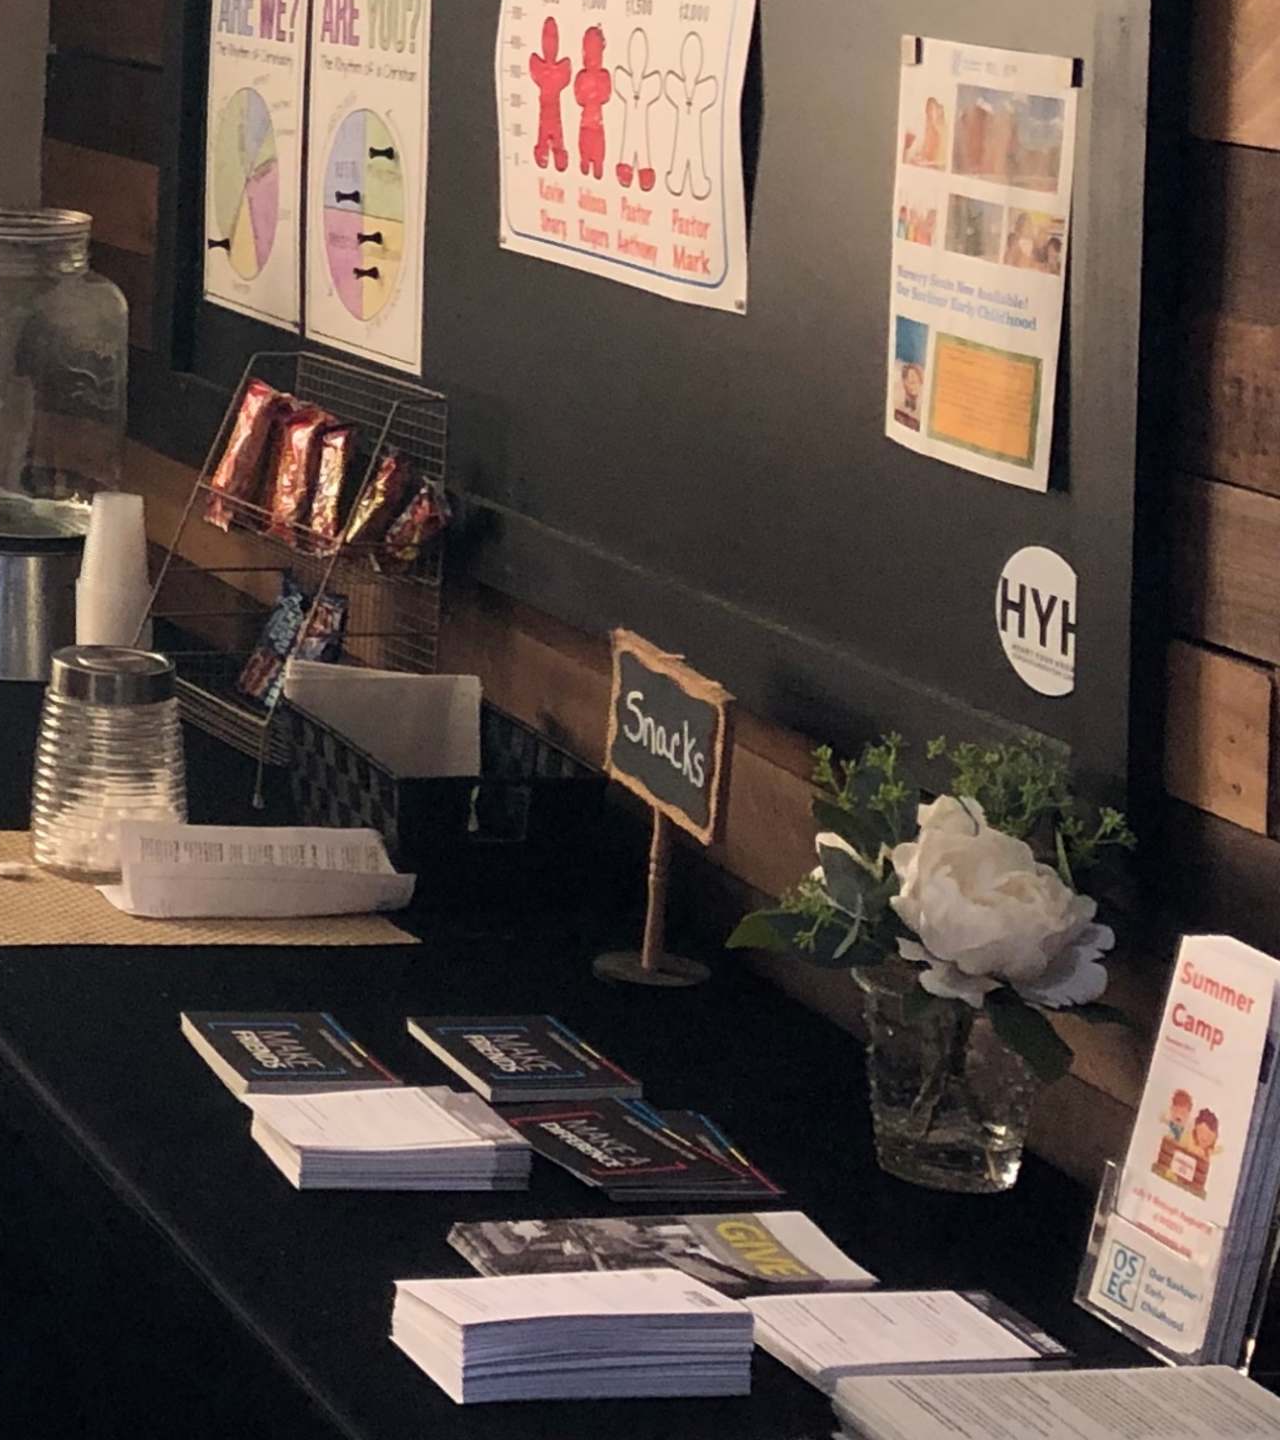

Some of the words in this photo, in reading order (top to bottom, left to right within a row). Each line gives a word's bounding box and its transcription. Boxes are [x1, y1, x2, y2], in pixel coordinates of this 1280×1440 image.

[671, 208, 711, 240] Pastor
[672, 243, 711, 276] Mark
[623, 690, 704, 788] Snacks
[1181, 960, 1255, 1015] Summer
[1171, 1002, 1225, 1052] Camp
[231, 1030, 287, 1069] FRIENDS
[257, 1030, 327, 1069] MAKE
[462, 1034, 525, 1073] FRIENDS
[492, 1034, 563, 1072] MAKE
[539, 1121, 626, 1168] DIFFERENCE
[560, 1119, 638, 1155] MAKE
[716, 1220, 809, 1277] GIVE
[1112, 1248, 1138, 1279] OS
[1106, 1273, 1133, 1305] EC
